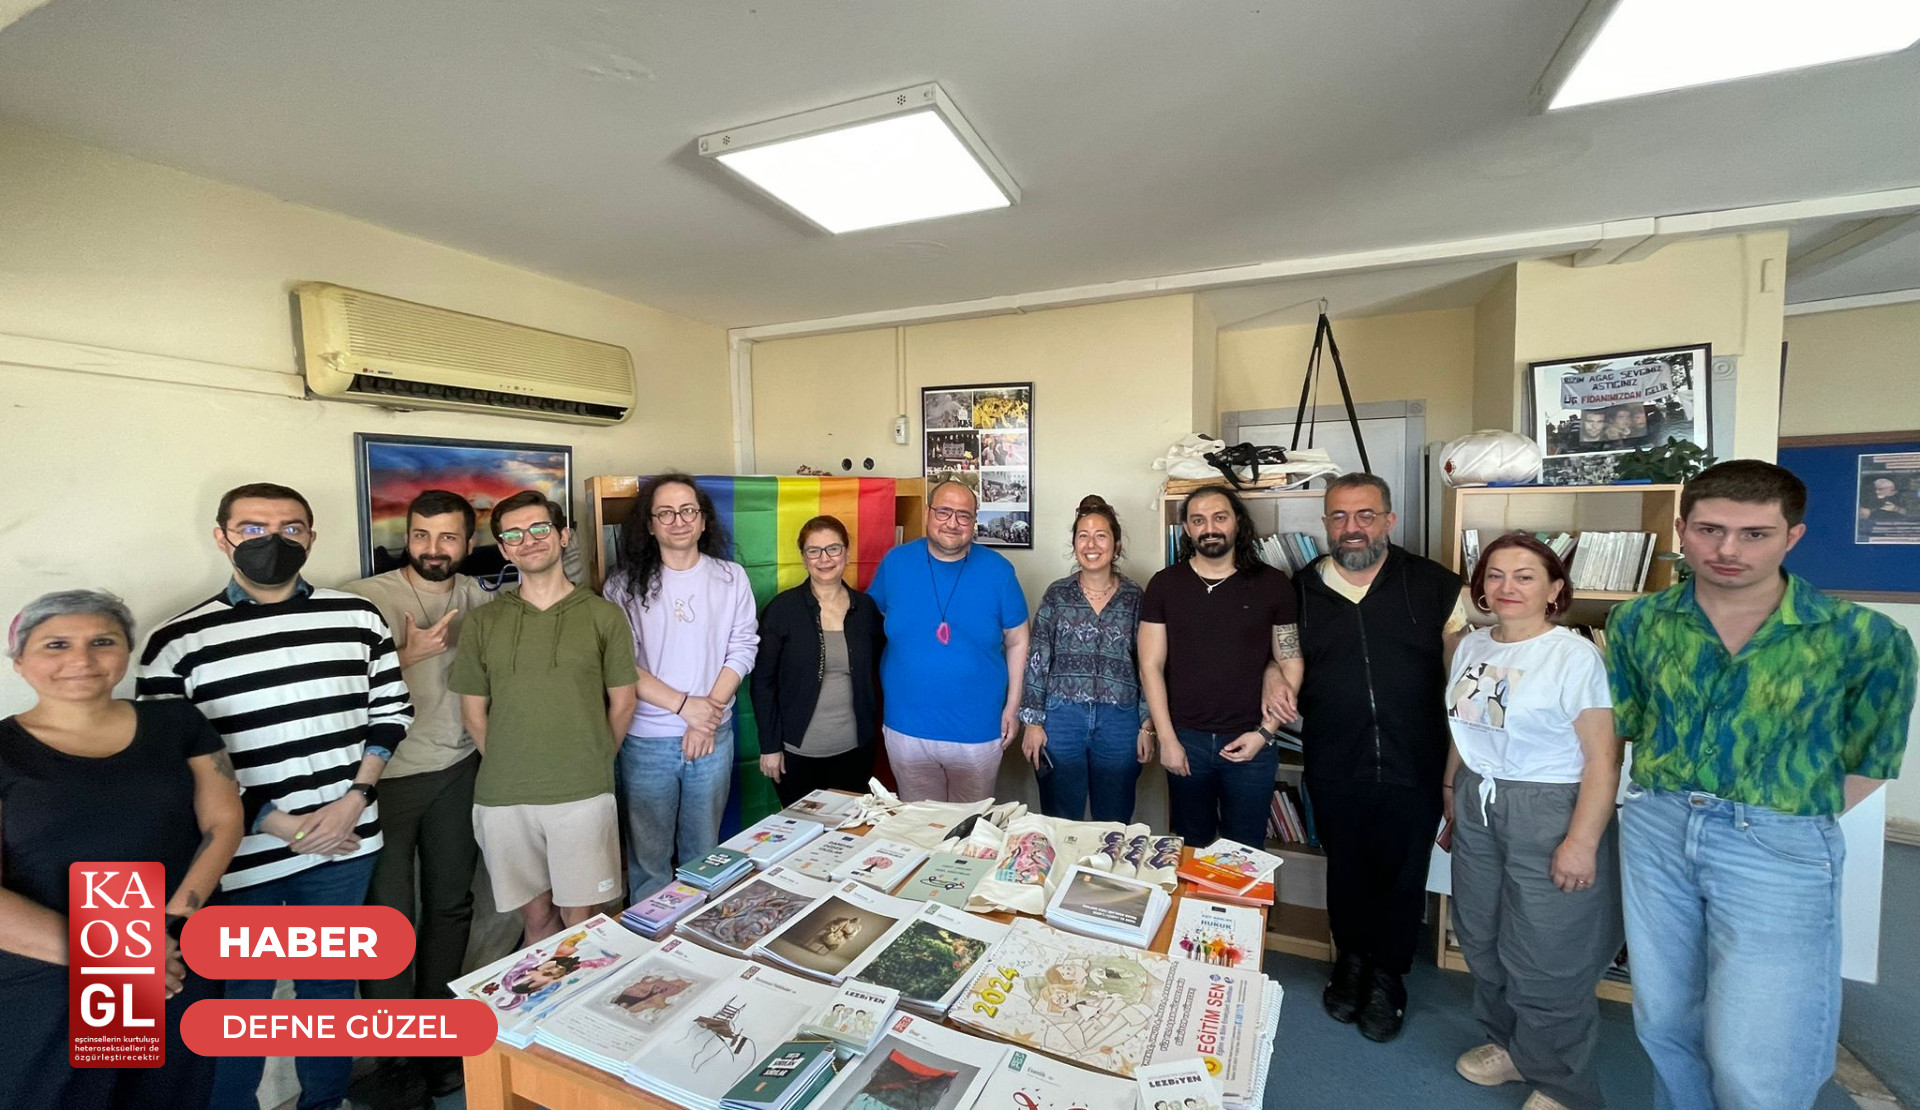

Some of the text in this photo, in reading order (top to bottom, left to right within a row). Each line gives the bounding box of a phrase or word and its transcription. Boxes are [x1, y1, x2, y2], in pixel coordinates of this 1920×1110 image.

[973, 965, 1020, 1019] 2024
[1196, 983, 1225, 1054] EĞİTİM SEN
